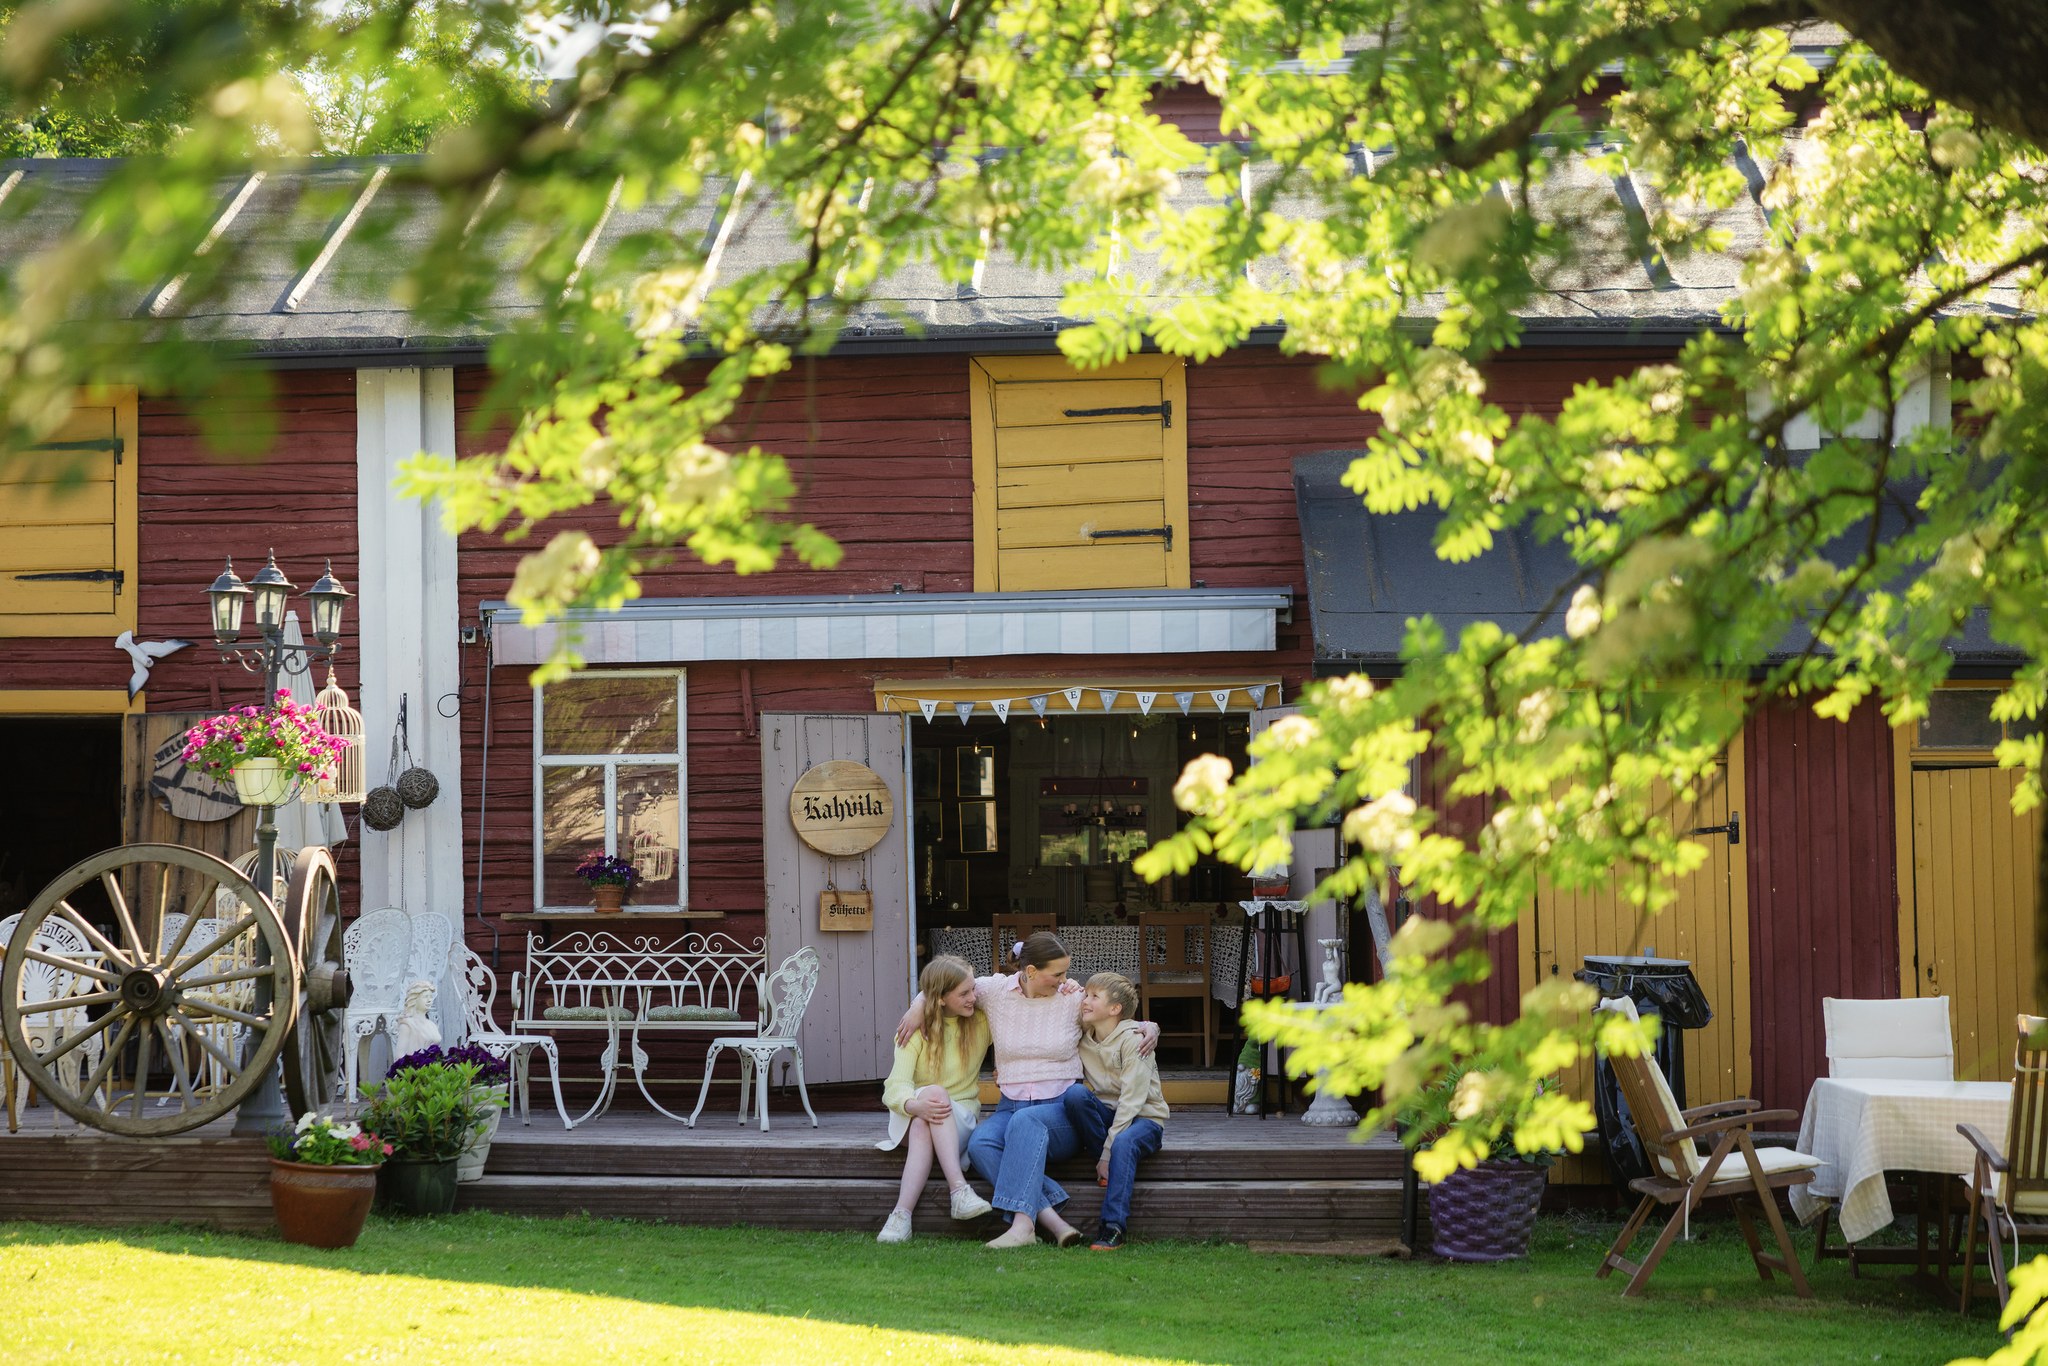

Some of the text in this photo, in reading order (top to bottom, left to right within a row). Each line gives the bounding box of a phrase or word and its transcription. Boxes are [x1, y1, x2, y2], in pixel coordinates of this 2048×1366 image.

[924, 688, 1263, 714] TERVETULOA
[155, 736, 190, 761] WELCO
[803, 793, 884, 822] Kahvila
[829, 903, 866, 917] Suljettu
